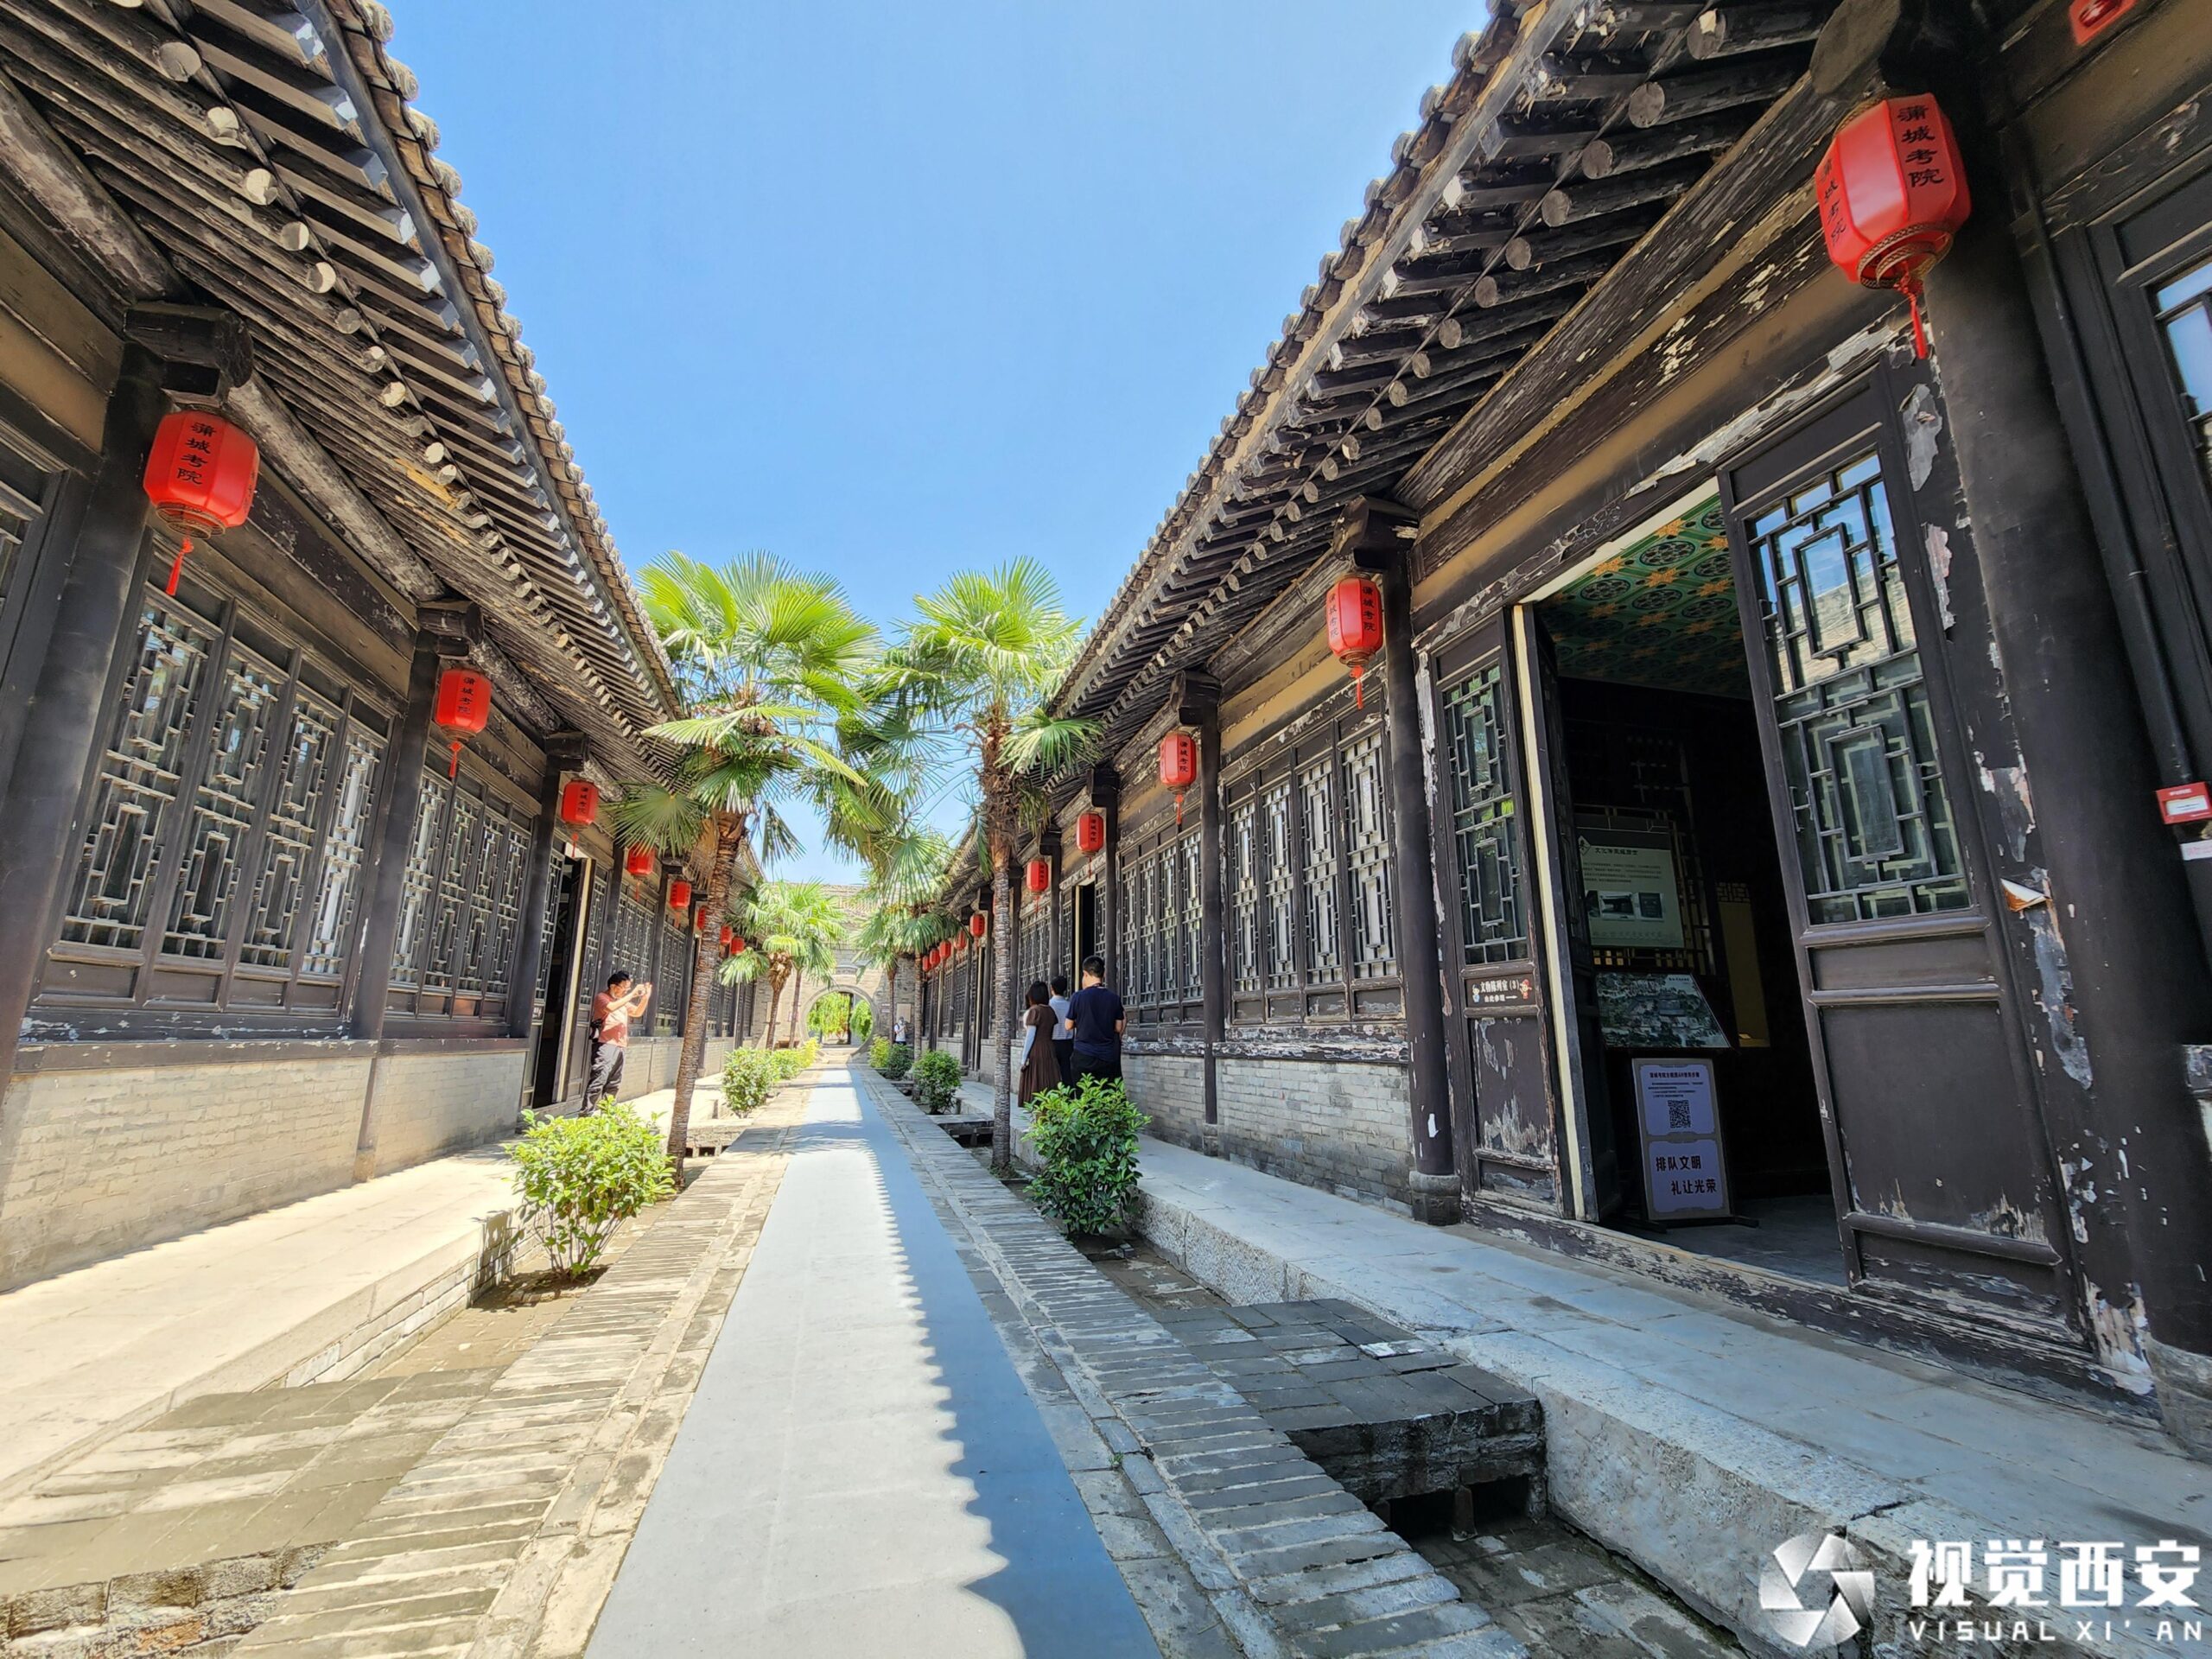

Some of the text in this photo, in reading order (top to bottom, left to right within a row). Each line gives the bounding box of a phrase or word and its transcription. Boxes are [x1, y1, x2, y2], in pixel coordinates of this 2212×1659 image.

[1897, 104, 1945, 188] 蒲城考院
[175, 422, 218, 486] 蒲城考院
[1362, 586, 1376, 632] 蒲城考院
[1656, 1156, 1701, 1172] 排队文明
[1670, 1179, 1717, 1196] 礼让光荣
